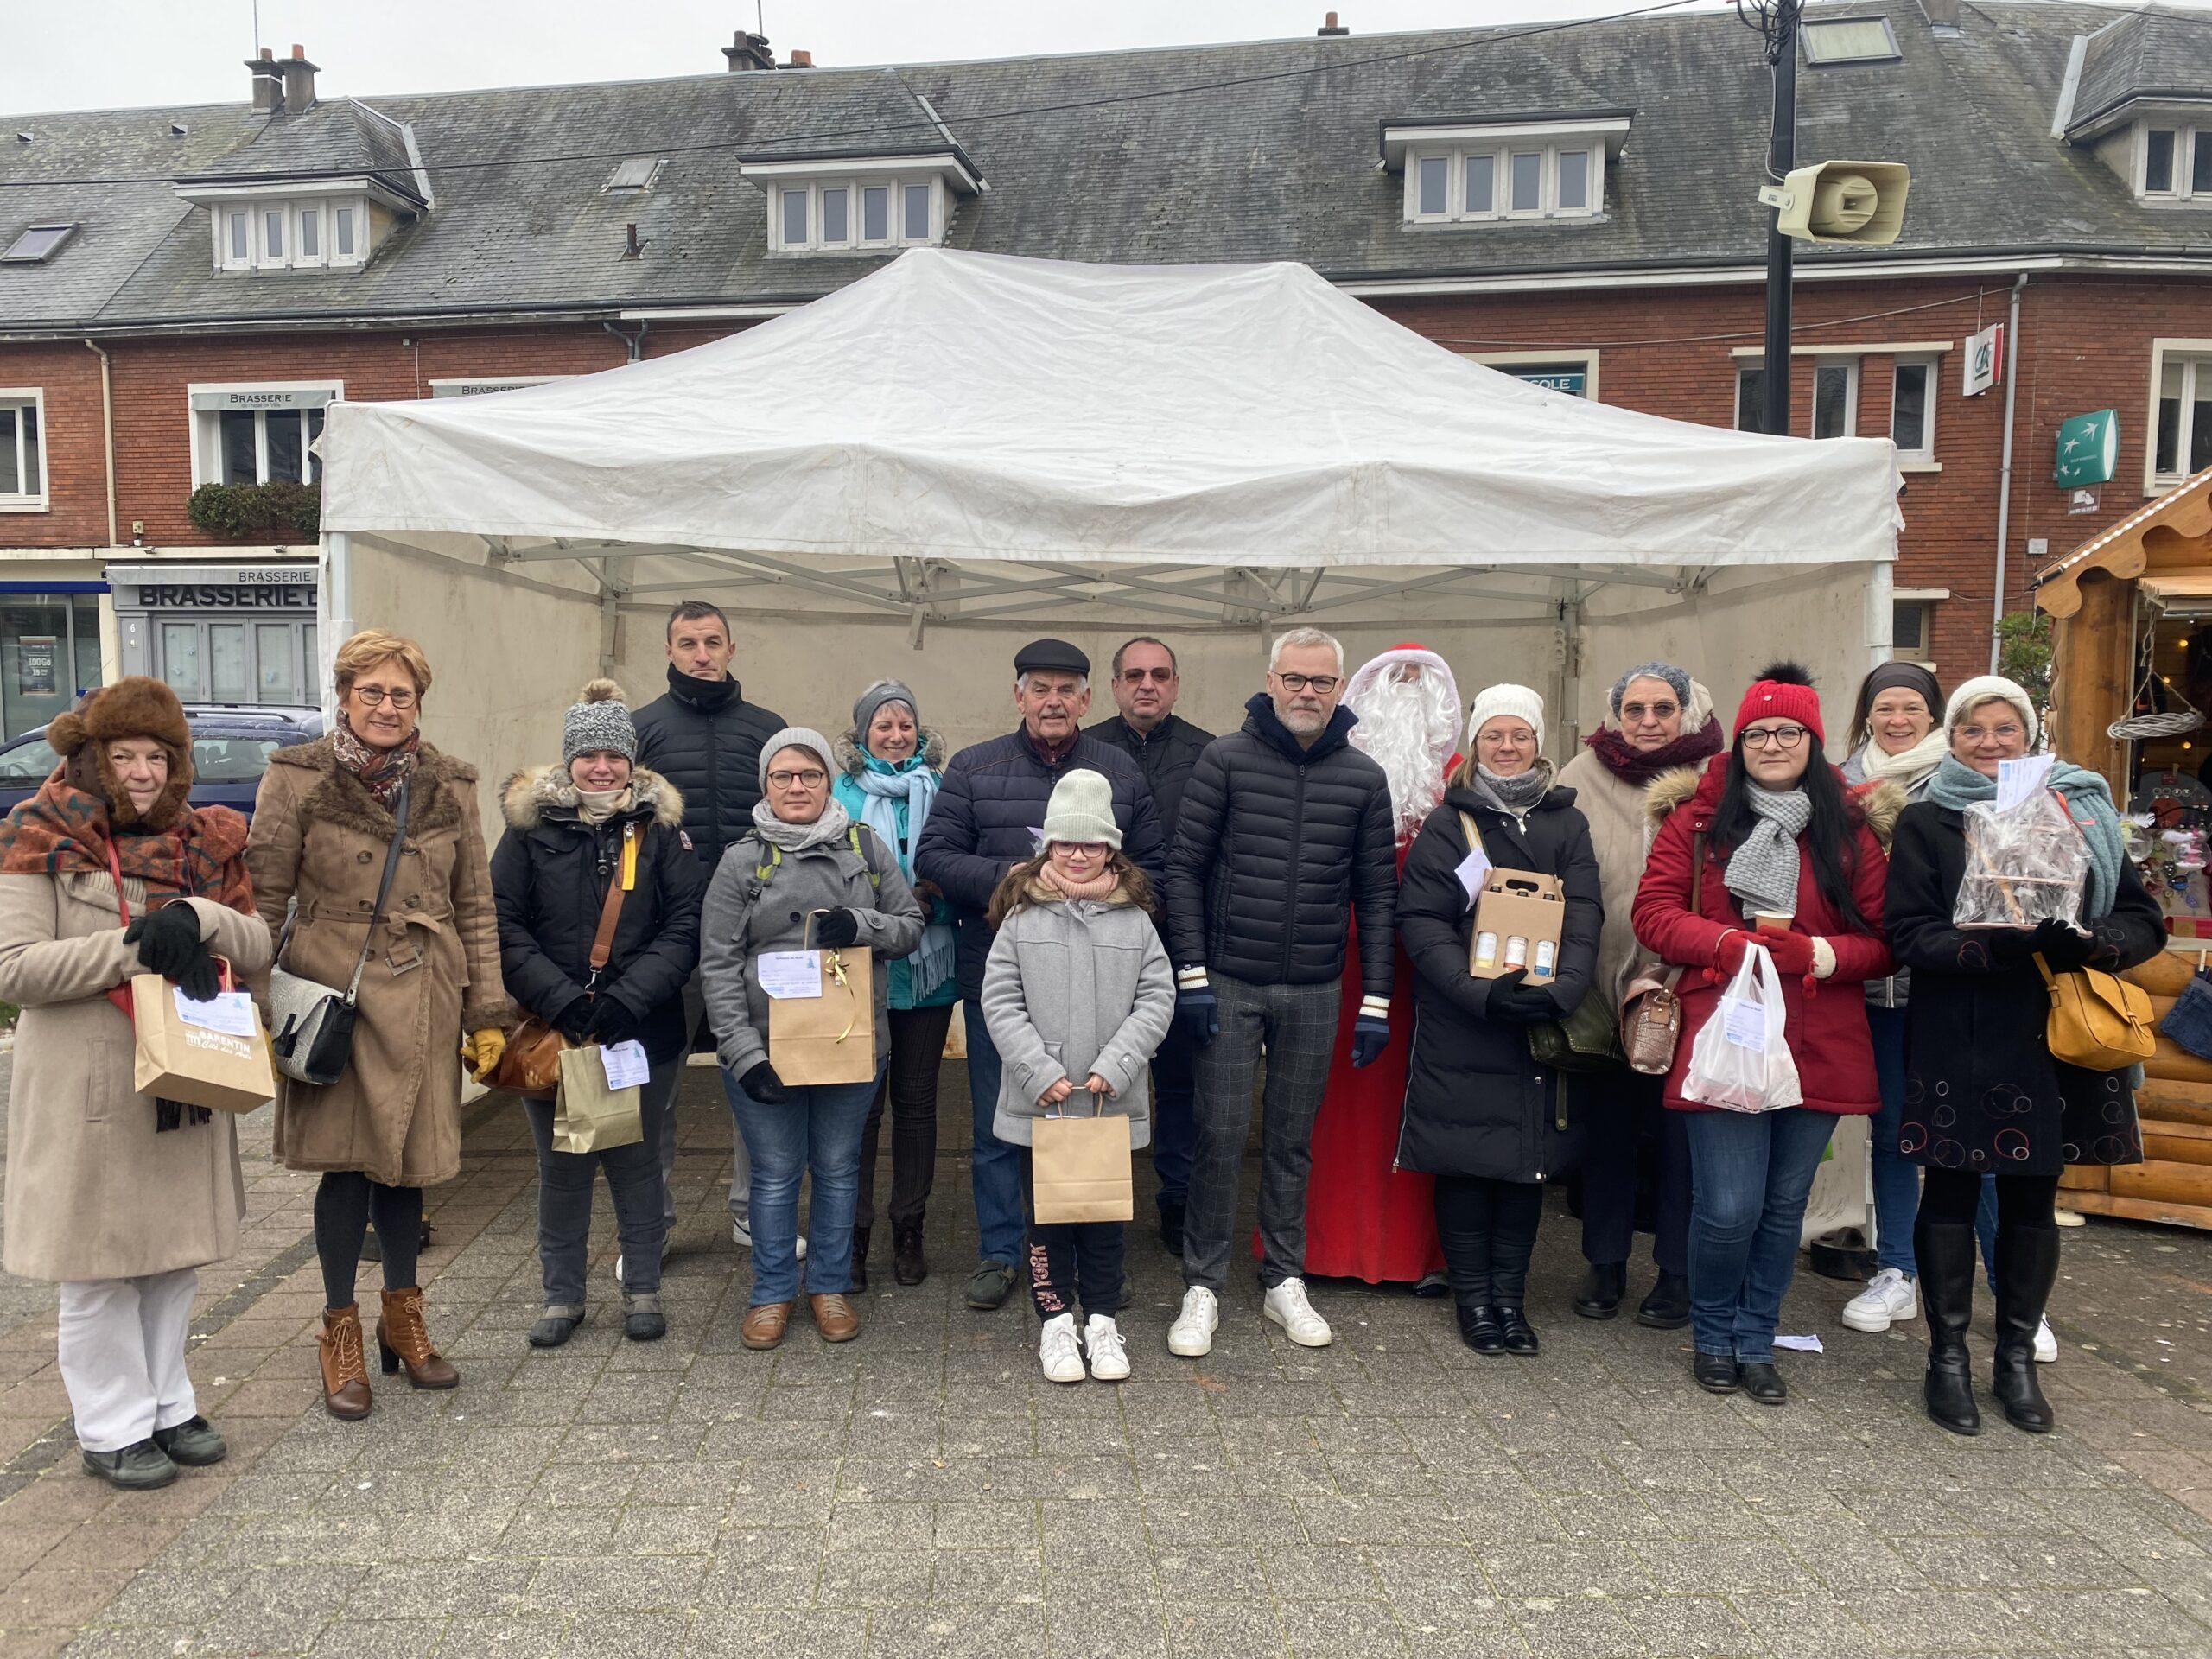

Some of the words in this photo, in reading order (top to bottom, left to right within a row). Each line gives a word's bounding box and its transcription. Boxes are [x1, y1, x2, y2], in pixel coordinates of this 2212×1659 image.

[231, 394, 292, 403] BRASSERIE
[238, 571, 311, 582] BRASSERIE
[139, 585, 301, 606] BRASSERIE
[130, 623, 136, 633] 6
[200, 1030, 251, 1053] BARENTIN
[1029, 1243, 1052, 1288] YORK
